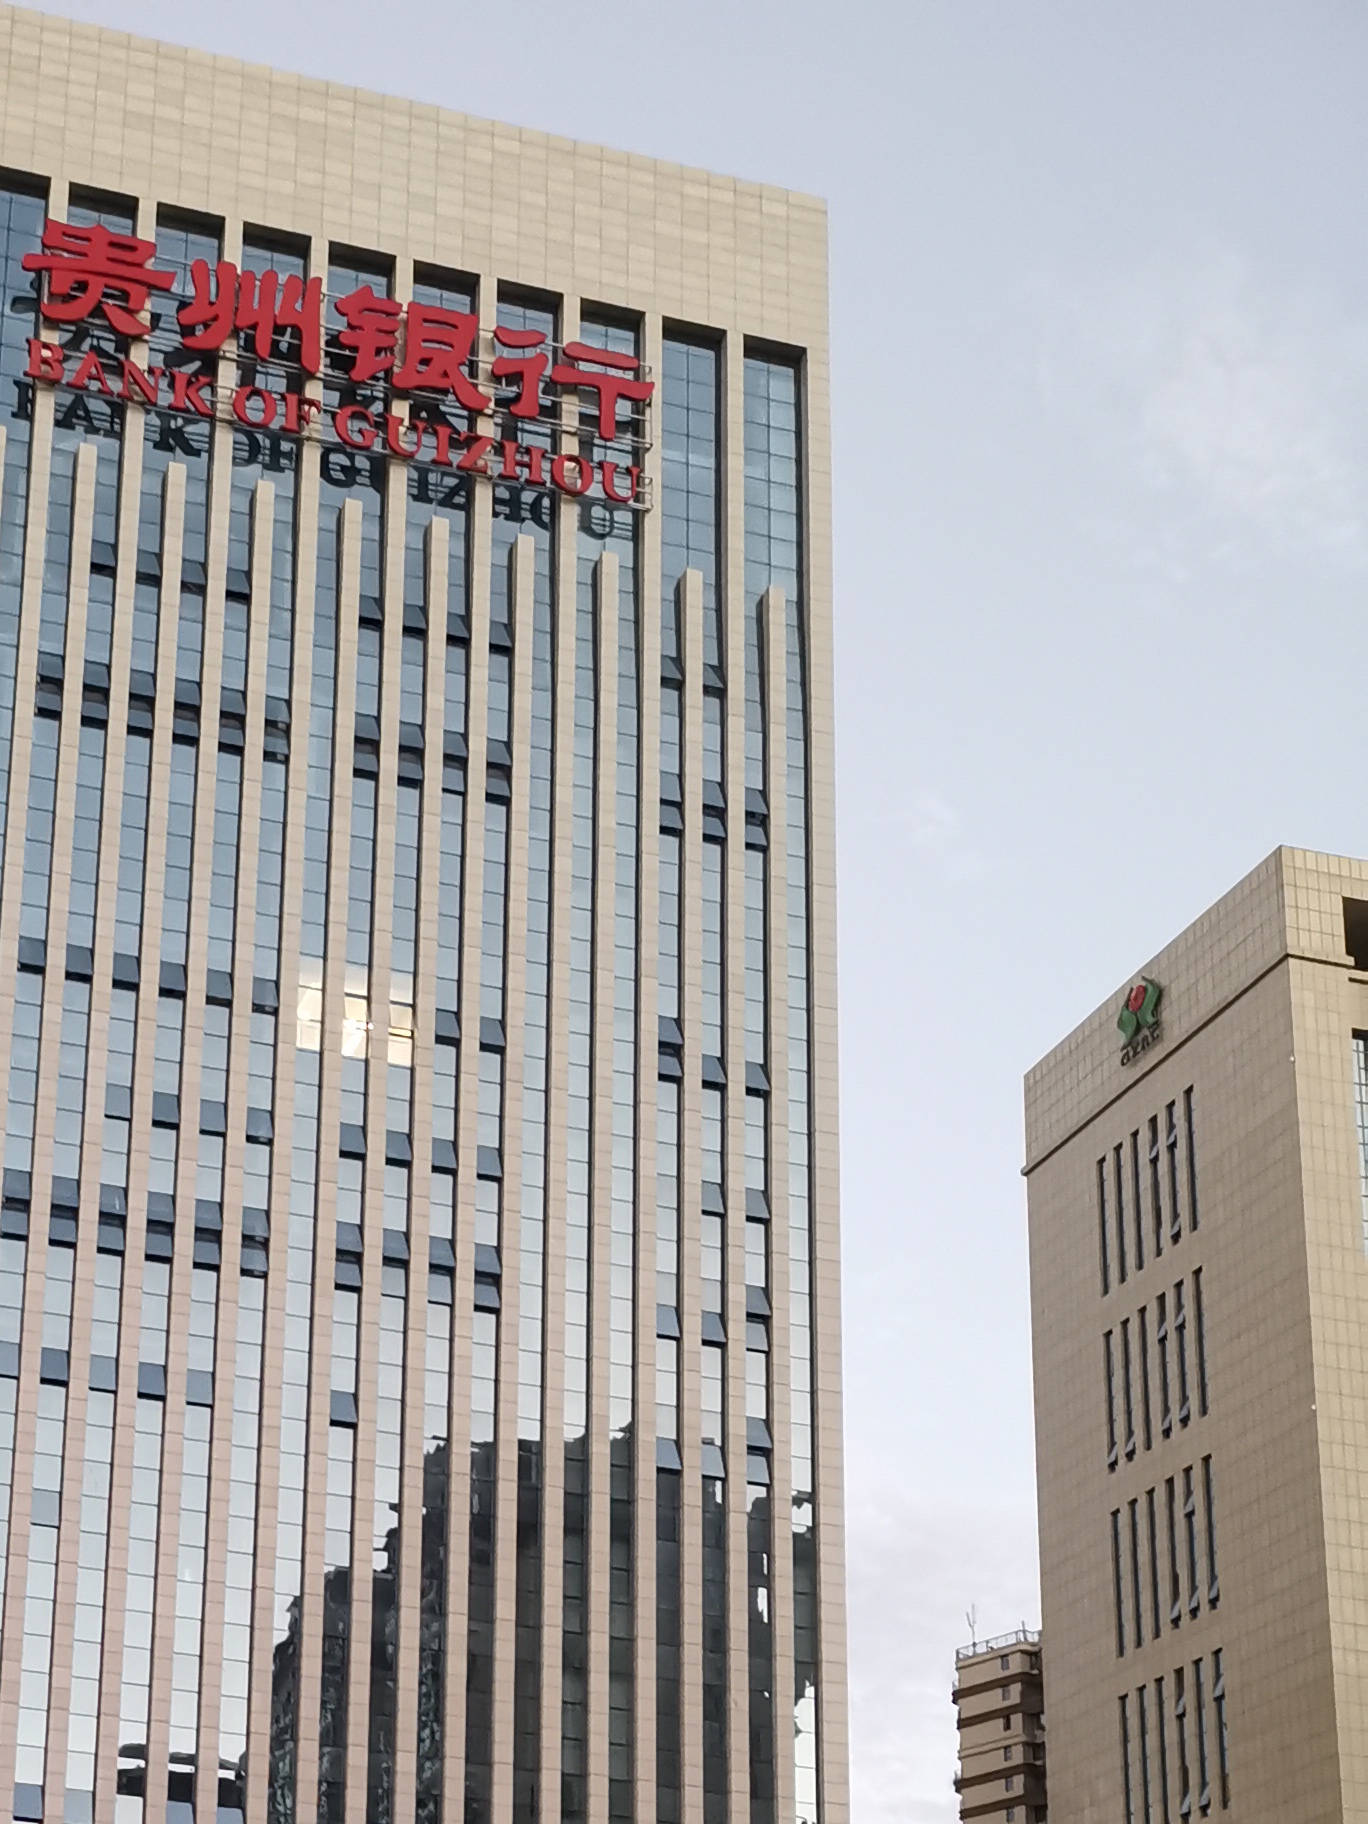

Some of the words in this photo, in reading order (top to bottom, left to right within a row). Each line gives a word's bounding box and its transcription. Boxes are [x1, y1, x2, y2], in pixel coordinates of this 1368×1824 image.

[22, 218, 655, 442] 贵州银行
[23, 337, 215, 417] BANK
[232, 385, 322, 433] OF
[334, 405, 641, 503] GUIZHOU
